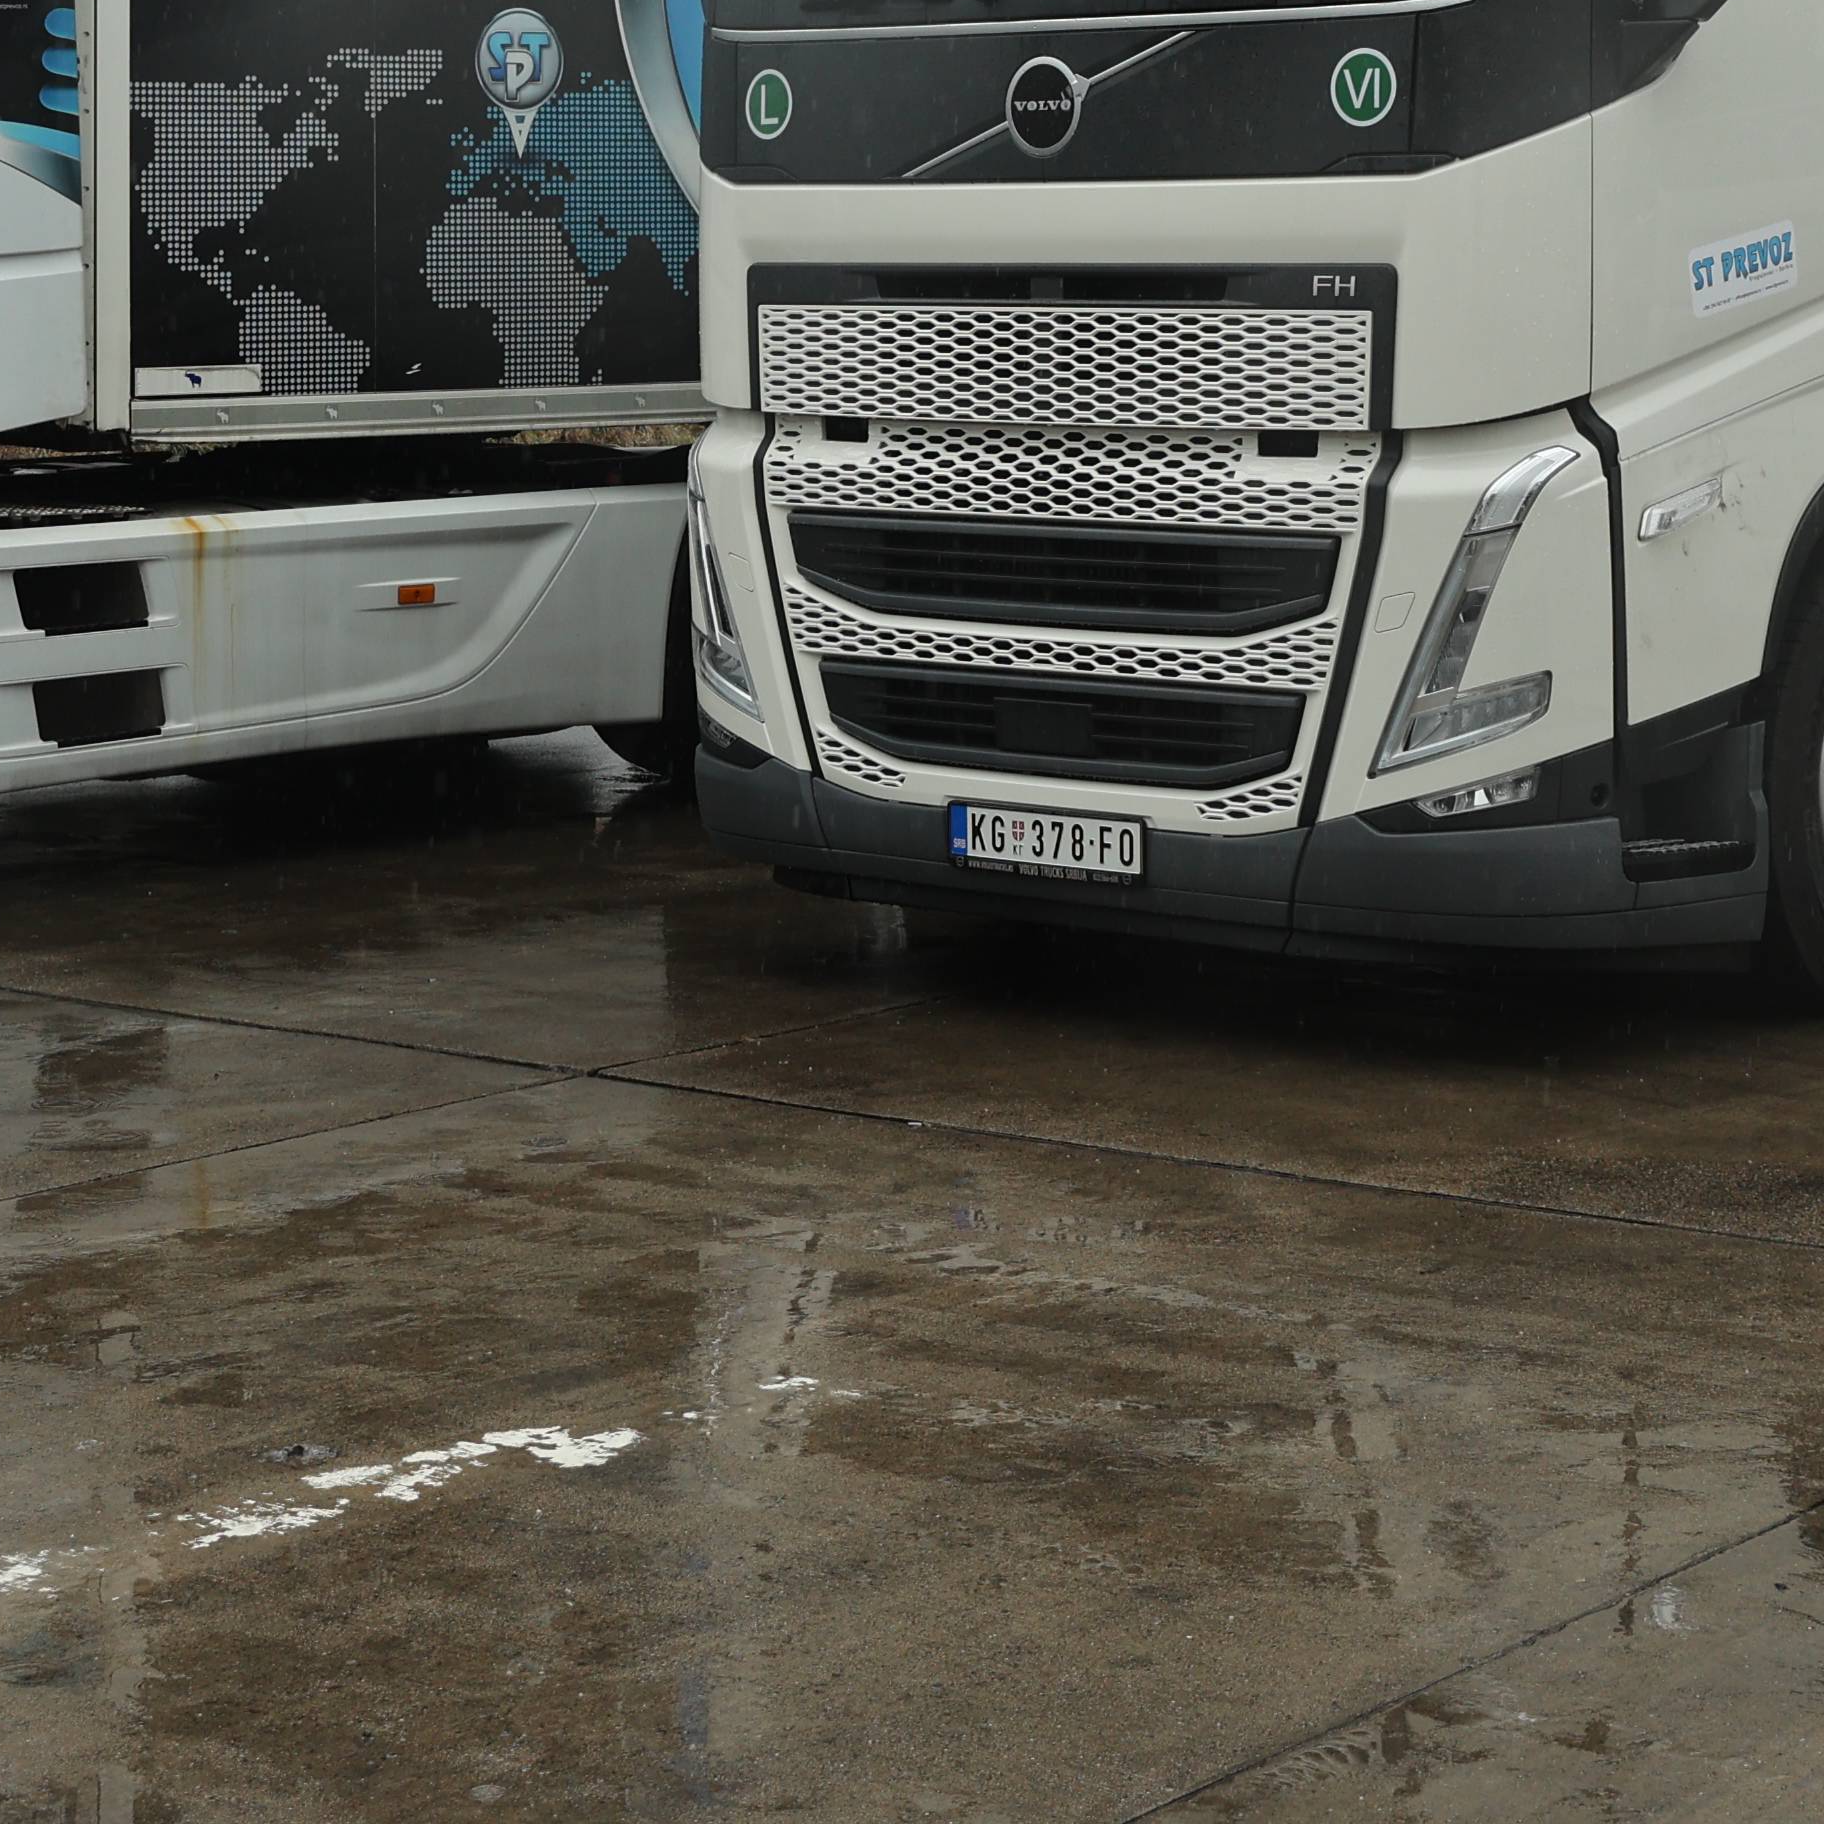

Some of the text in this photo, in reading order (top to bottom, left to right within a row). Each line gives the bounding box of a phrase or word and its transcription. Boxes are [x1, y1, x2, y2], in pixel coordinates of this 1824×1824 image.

[760, 84, 779, 125] L
[1014, 98, 1072, 112] VOLVO
[1342, 67, 1381, 109] VI
[1692, 231, 1794, 292] ST PREVOZ
[1312, 274, 1356, 297] FH
[971, 812, 1006, 853] KG
